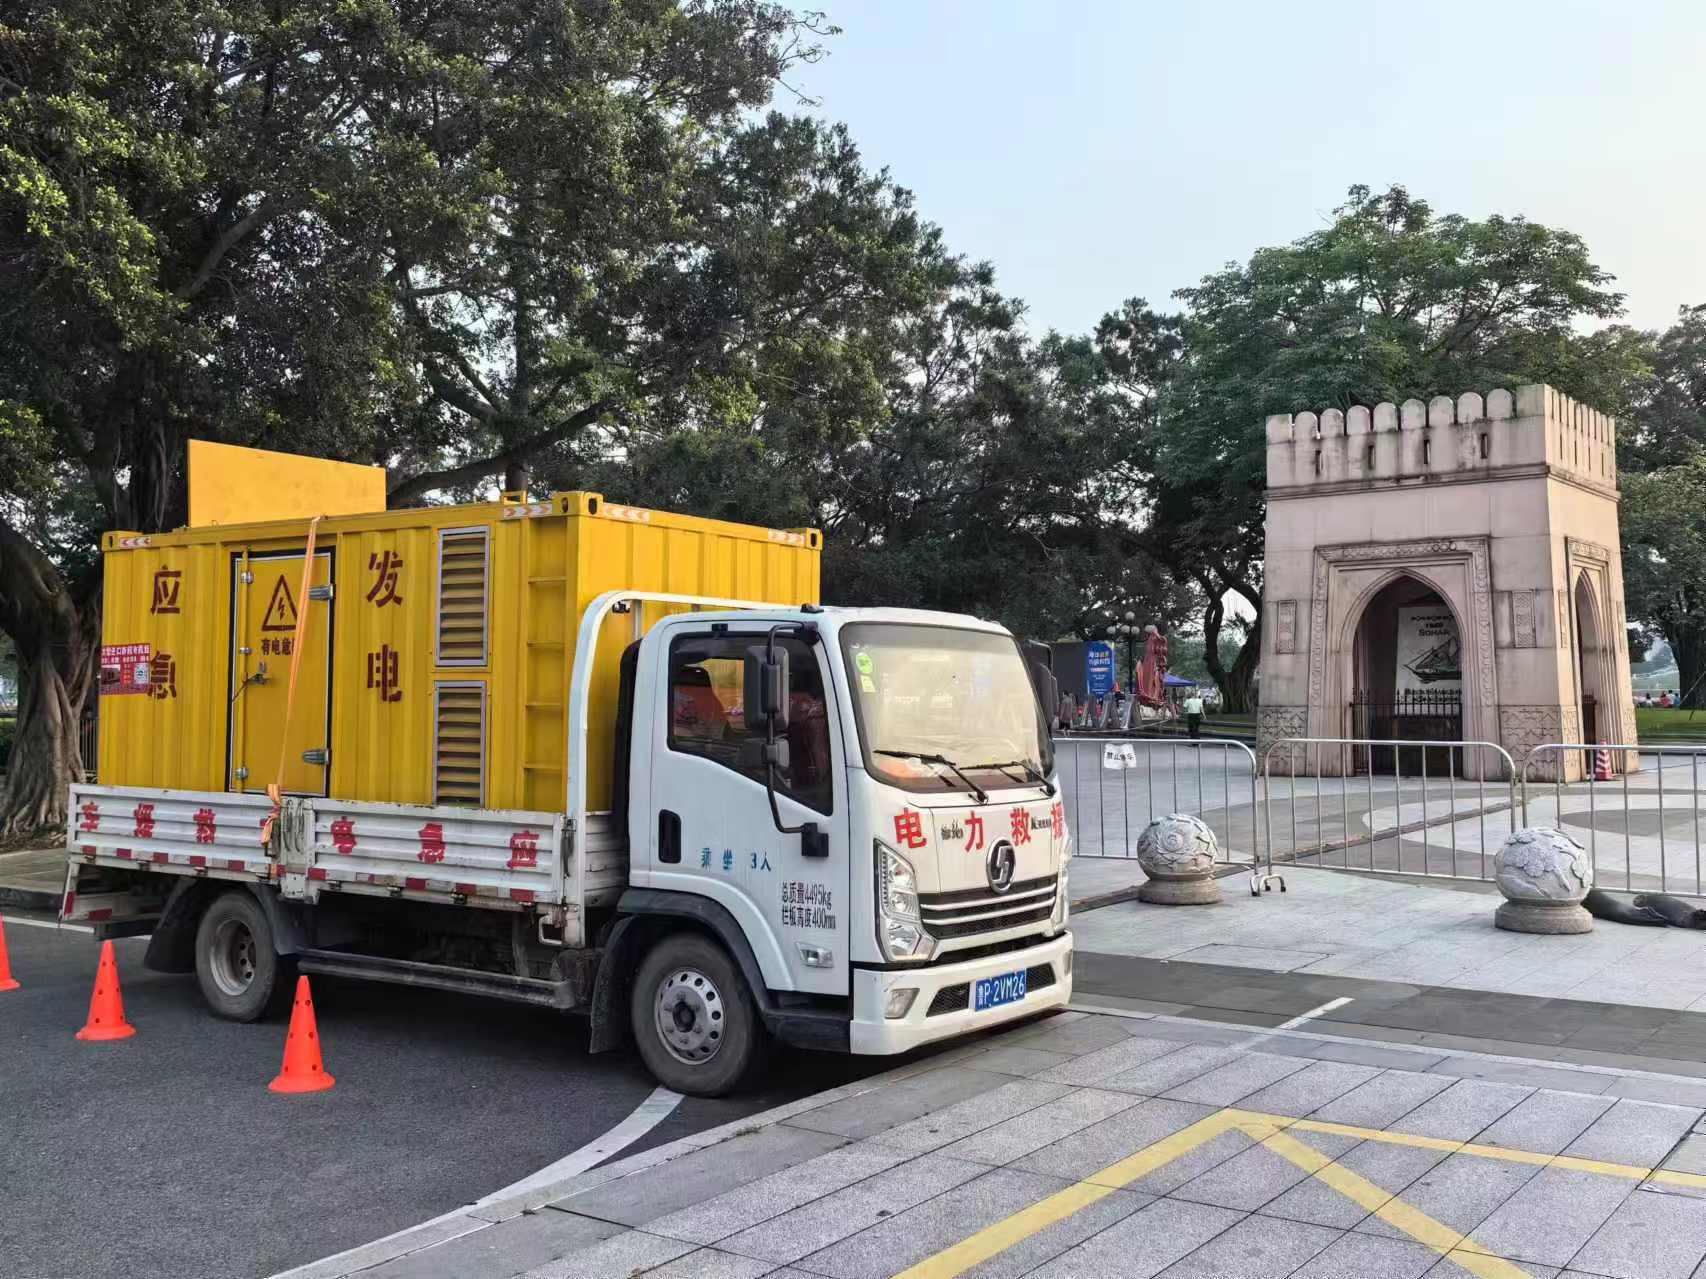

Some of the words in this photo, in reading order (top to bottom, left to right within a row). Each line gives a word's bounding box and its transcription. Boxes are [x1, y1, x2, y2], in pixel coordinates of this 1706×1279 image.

[148, 564, 182, 700] 应急
[261, 637, 294, 656] 有电危
[365, 550, 404, 703] 发电
